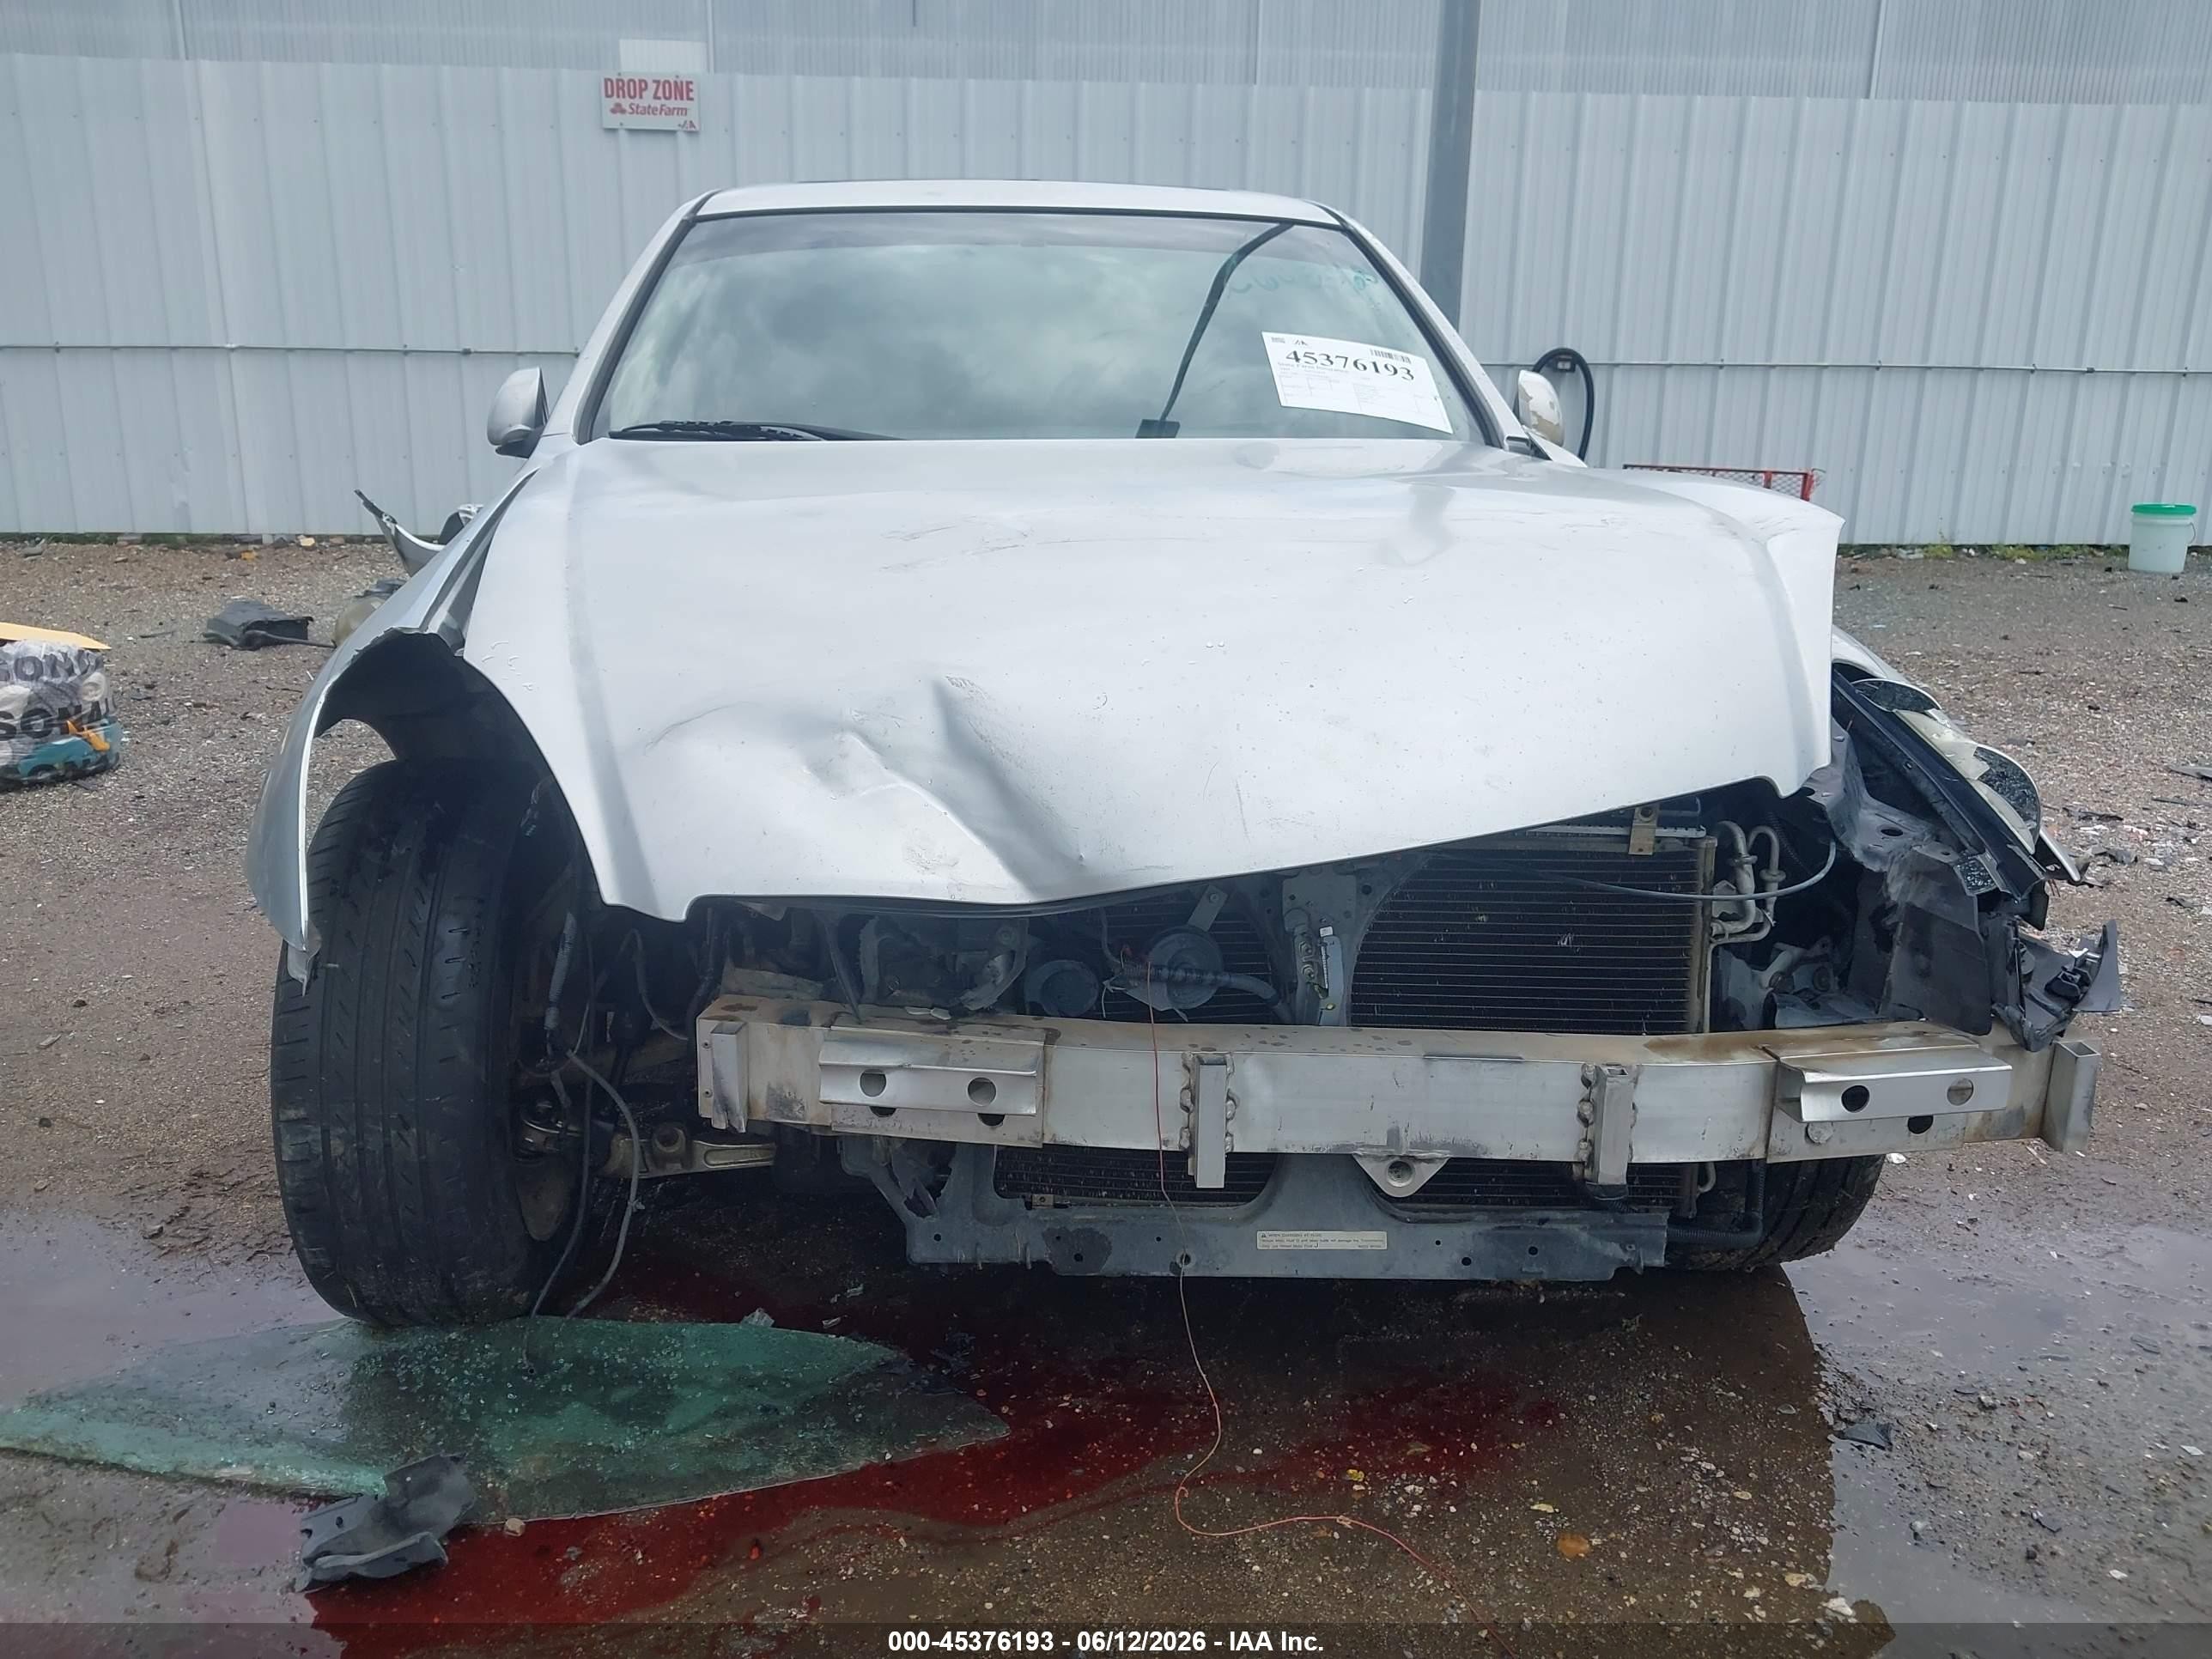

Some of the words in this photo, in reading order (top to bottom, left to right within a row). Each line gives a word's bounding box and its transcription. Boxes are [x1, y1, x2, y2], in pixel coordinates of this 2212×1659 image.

[604, 77, 648, 100] DROP
[652, 79, 695, 101] ZONE
[1285, 350, 1415, 381] 45376193
